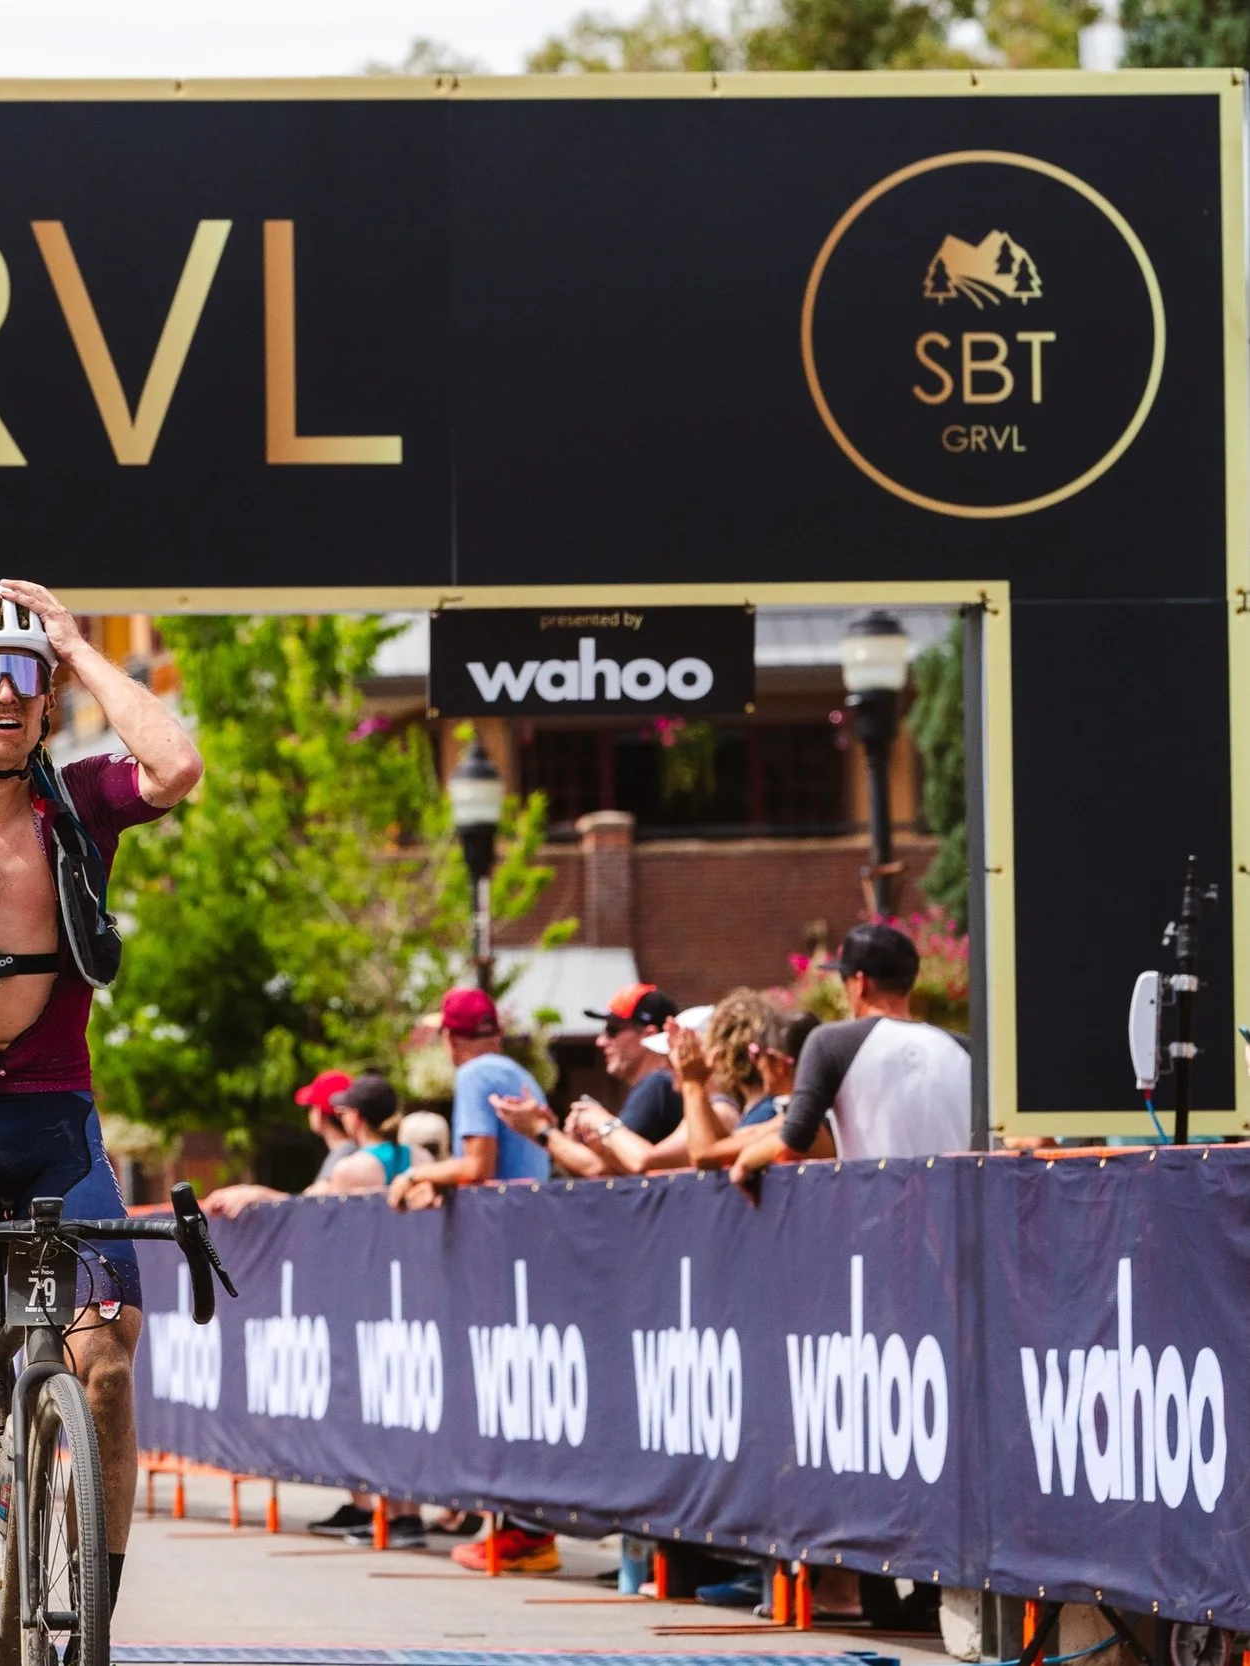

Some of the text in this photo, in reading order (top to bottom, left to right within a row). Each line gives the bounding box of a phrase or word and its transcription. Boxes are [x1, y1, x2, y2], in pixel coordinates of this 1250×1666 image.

[912, 331, 1057, 405] SBT
[942, 425, 1027, 453] GRVL
[466, 637, 714, 702] wahoo
[540, 612, 644, 630] presented by
[28, 1277, 56, 1307] 79
[245, 1261, 331, 1421] wahoo
[356, 1260, 443, 1434] wahoo
[468, 1259, 588, 1447] wahoo
[632, 1256, 742, 1462] wahoo
[786, 1255, 949, 1484] wahoo
[1020, 1258, 1227, 1513] wahoo
